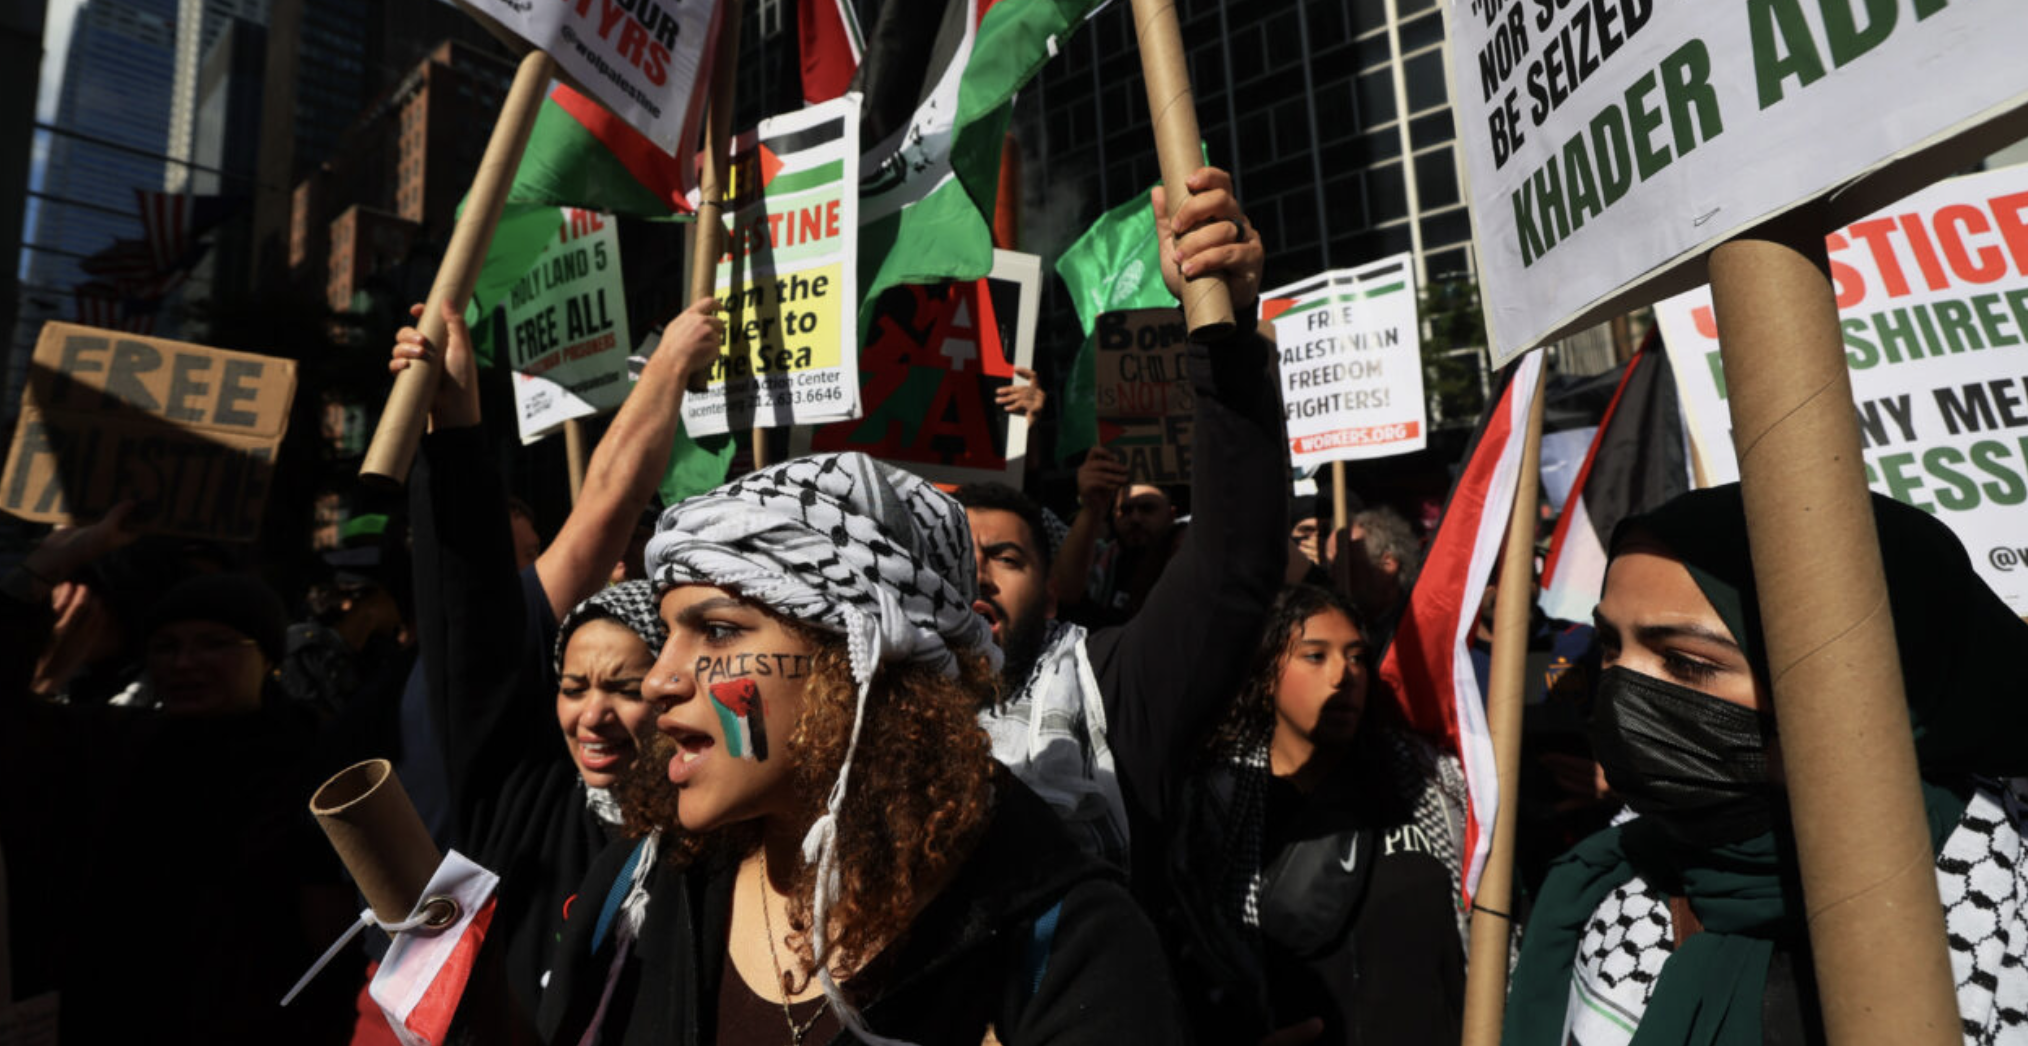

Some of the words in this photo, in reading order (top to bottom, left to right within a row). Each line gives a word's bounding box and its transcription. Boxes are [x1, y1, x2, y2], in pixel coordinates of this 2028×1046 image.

[1479, 1, 1529, 104] NOR
[561, 24, 661, 119] @wolpalestine
[1489, 87, 1525, 171] BE
[1527, 0, 1653, 127] SEIZED
[1512, 38, 1724, 268] KHADER
[1747, 0, 1949, 111] AD
[510, 266, 540, 310] HOLY
[544, 249, 589, 290] LAND
[593, 240, 607, 272] 5
[776, 275, 829, 304] the
[514, 305, 558, 365] FREE
[566, 288, 614, 342] ALL
[785, 311, 817, 336] to
[757, 345, 812, 373] Sea
[1288, 359, 1383, 391] FREEDOM
[51, 335, 264, 427] FREE
[797, 371, 840, 387] Center
[1117, 381, 1170, 413] NOT
[1286, 387, 1391, 421] FIGHTERS!
[1301, 424, 1407, 451] WORKERS.ORG
